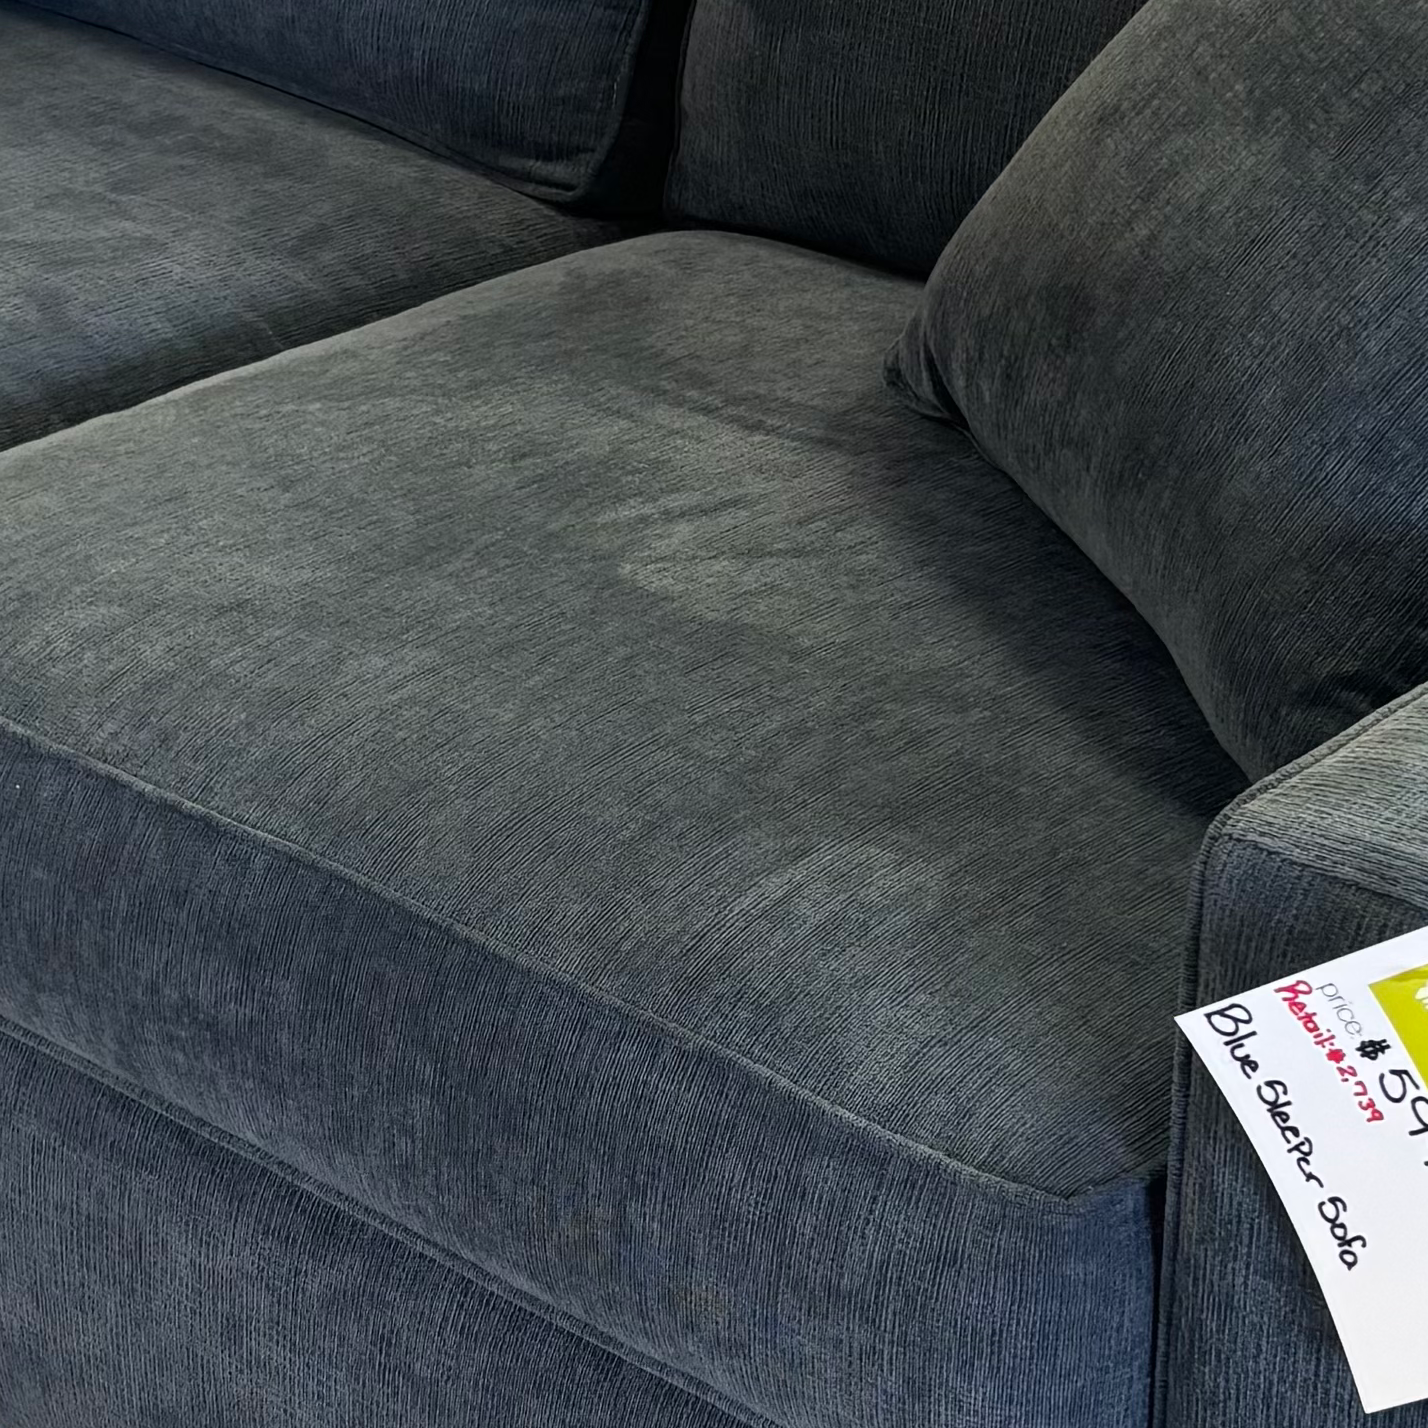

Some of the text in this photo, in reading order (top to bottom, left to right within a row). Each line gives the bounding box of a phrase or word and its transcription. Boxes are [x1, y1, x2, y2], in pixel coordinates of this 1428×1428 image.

[1315, 982, 1363, 1040] price:
[1203, 1001, 1262, 1082] Blue
[1316, 1195, 1368, 1273] Sofa
